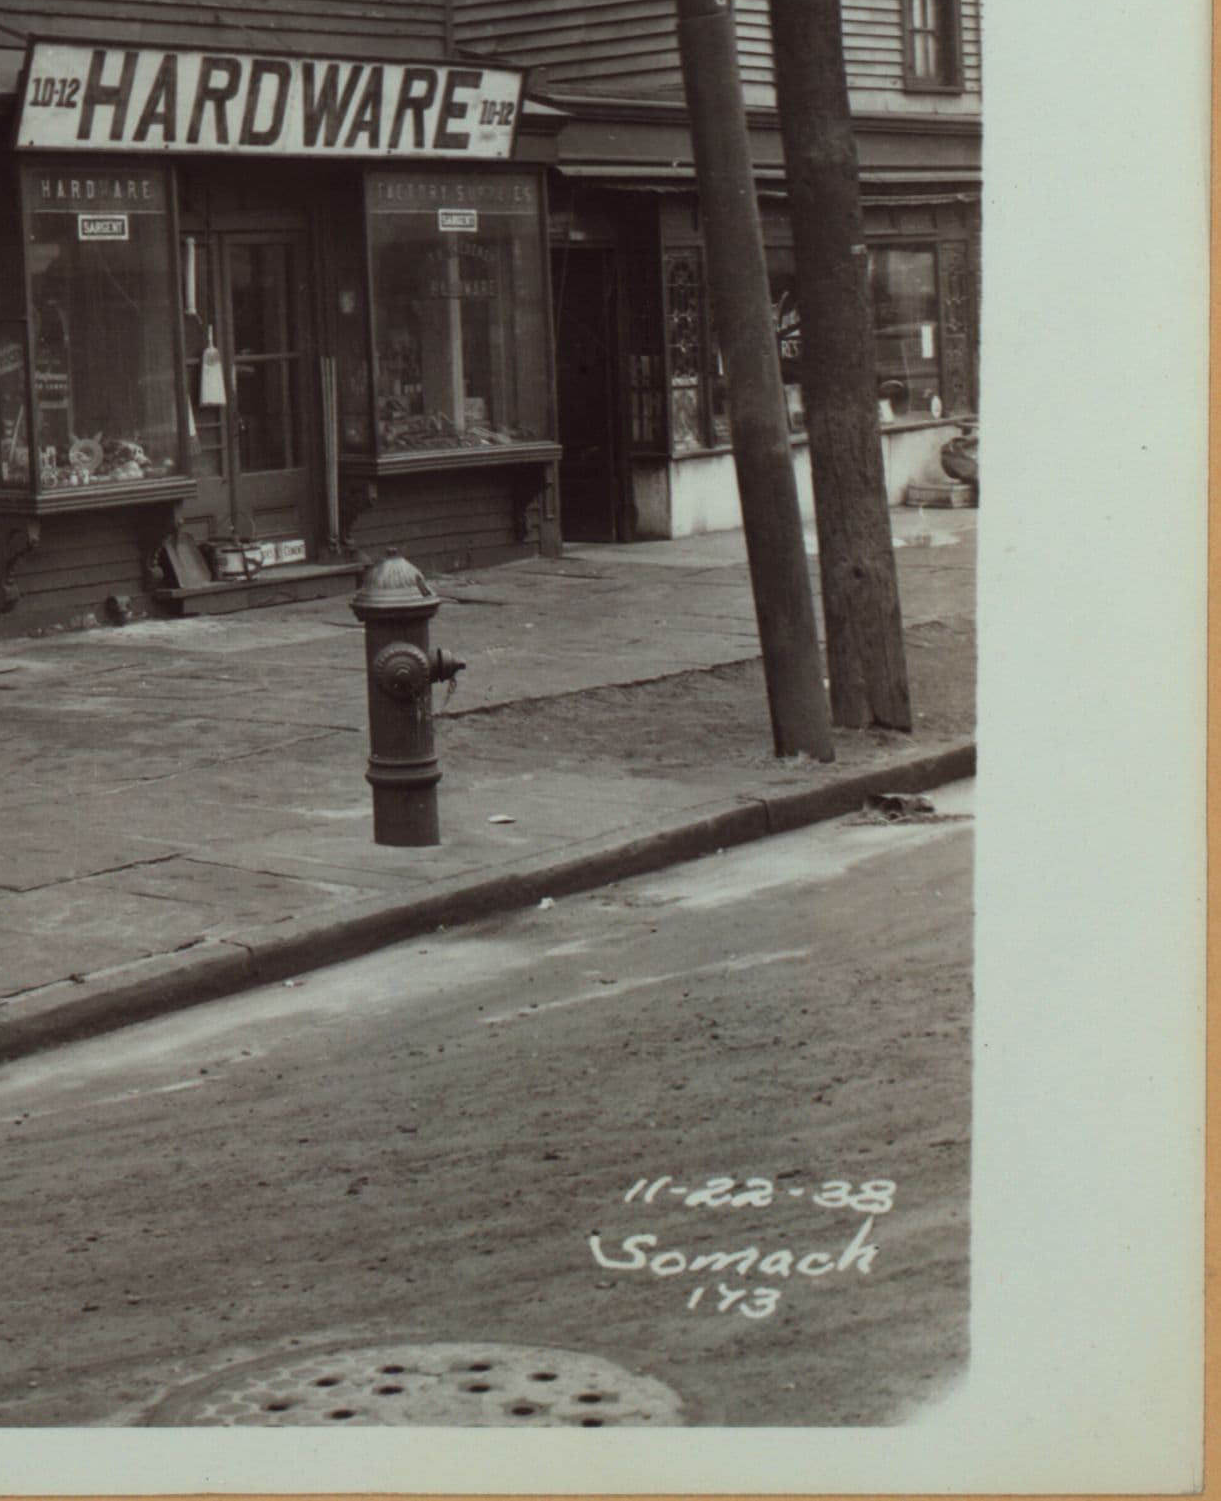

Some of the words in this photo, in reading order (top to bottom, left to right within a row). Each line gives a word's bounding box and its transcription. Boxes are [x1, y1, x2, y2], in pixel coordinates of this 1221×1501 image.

[29, 77, 81, 109] 10-12
[76, 49, 484, 150] HARDWARE
[479, 99, 514, 126] 10-12
[41, 179, 151, 200] HARDWARE
[82, 220, 124, 235] SARGENT
